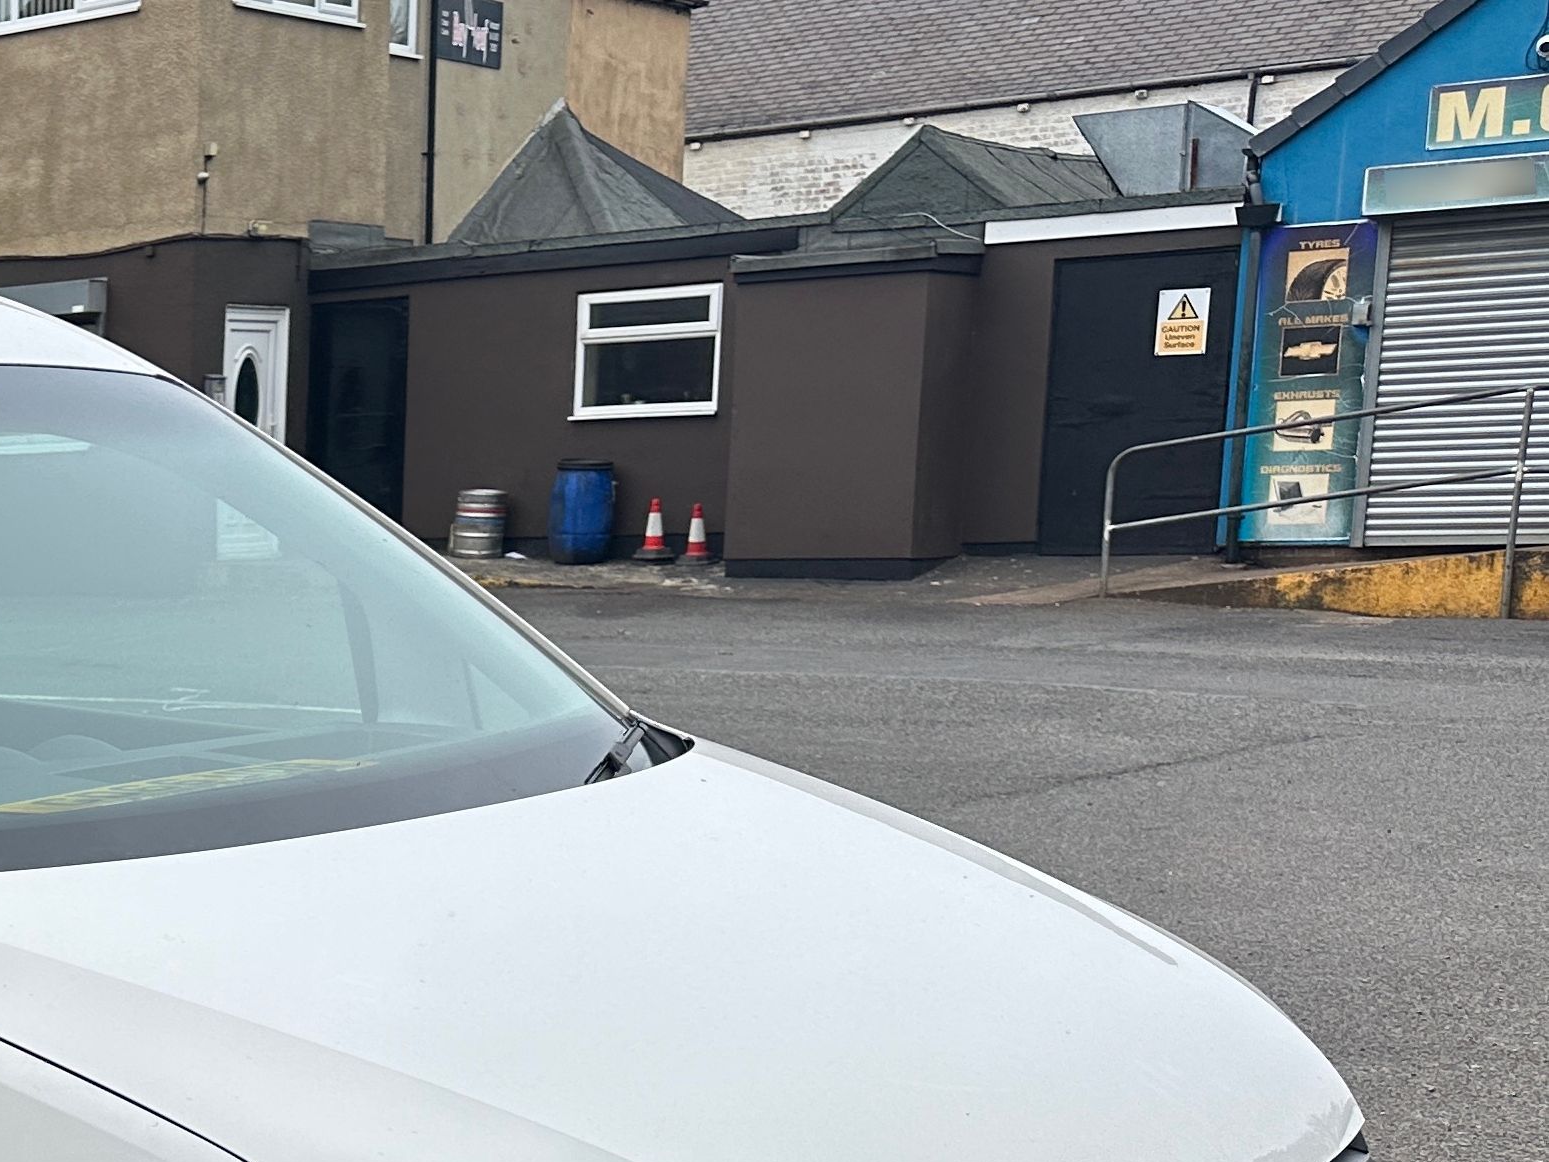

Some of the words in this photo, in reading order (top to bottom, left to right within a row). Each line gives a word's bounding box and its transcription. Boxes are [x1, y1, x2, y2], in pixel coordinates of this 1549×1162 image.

[1435, 84, 1549, 142] M.
[1299, 239, 1341, 249] TYRES
[1278, 316, 1304, 326] ALL
[1305, 313, 1348, 325] MAKES
[1161, 324, 1201, 333] CAUTION
[1163, 341, 1195, 349] Surface
[1274, 389, 1341, 400] EXHAUSTS
[1260, 464, 1342, 474] DIAGNOSTICS
